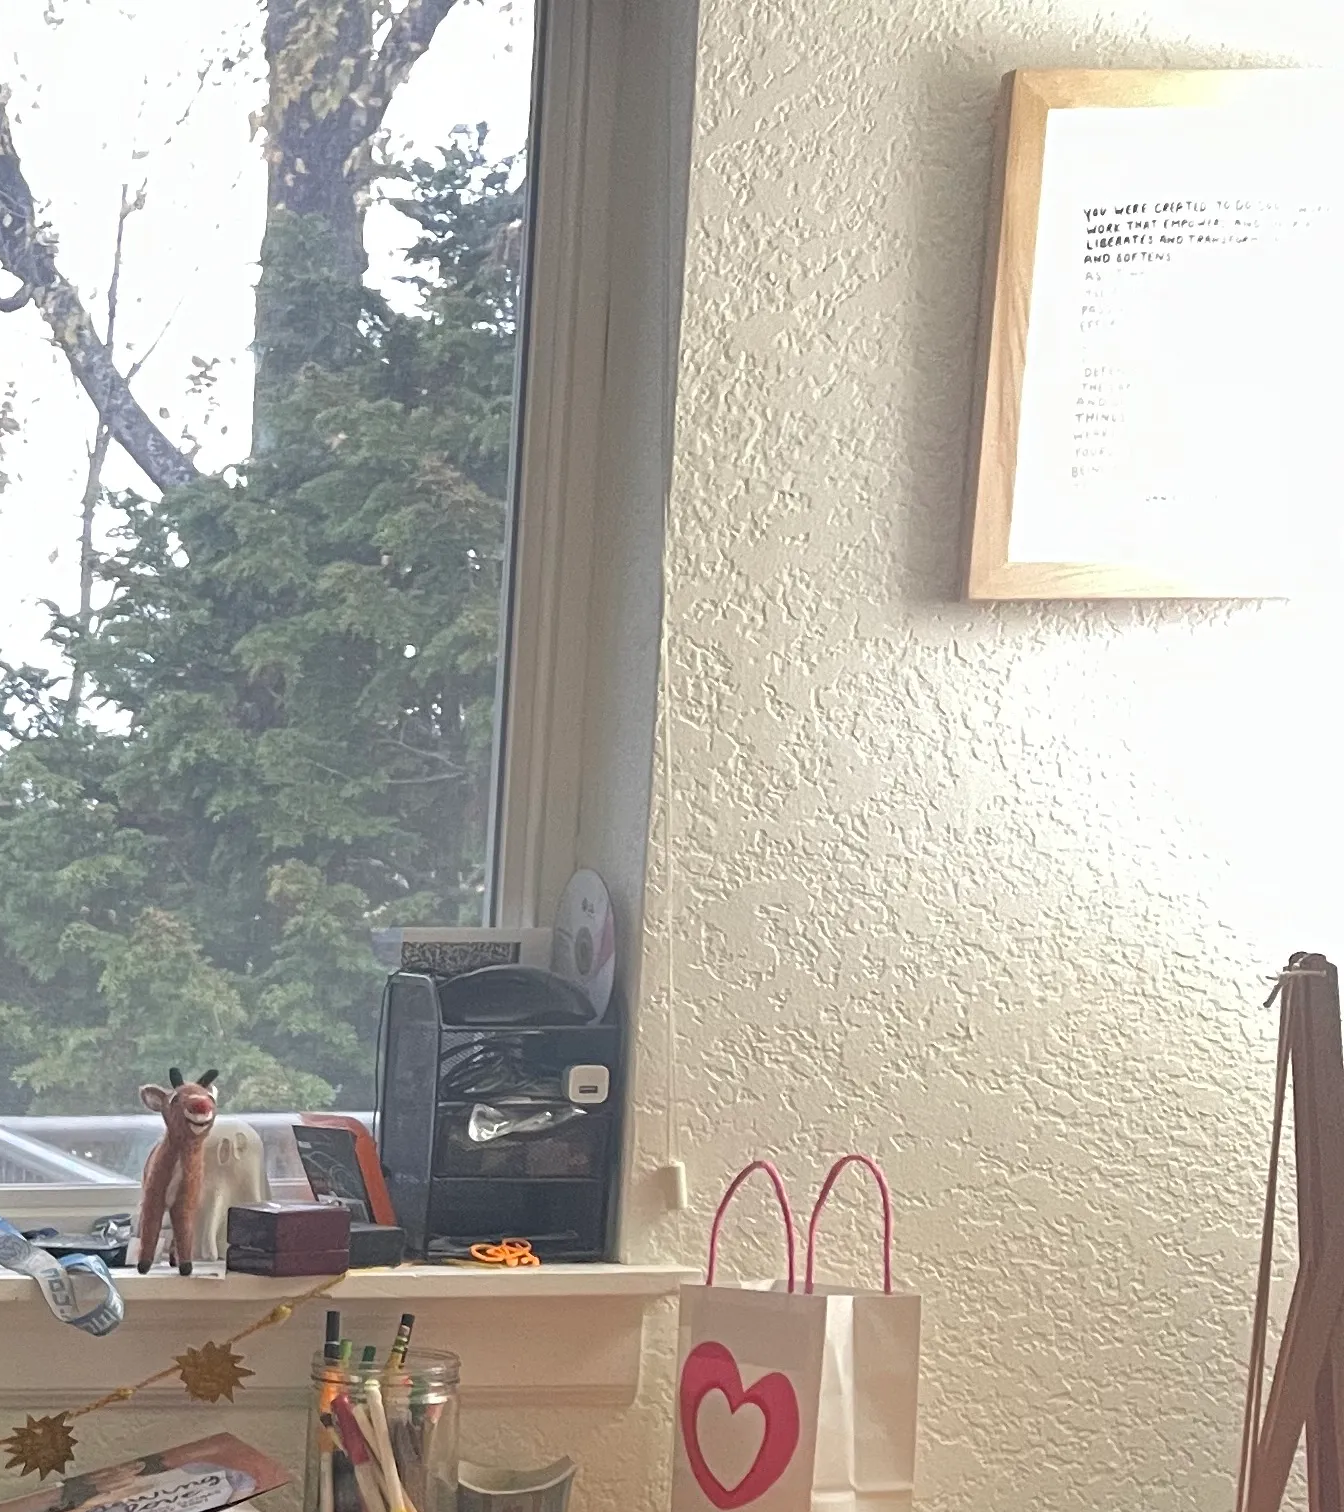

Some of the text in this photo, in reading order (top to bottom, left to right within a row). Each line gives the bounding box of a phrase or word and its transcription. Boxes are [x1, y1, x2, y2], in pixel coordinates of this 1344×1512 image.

[1083, 207, 1107, 222] YOU
[1114, 203, 1147, 214] WERE
[1154, 200, 1207, 213] CREATED
[1086, 223, 1120, 235] WORK
[1127, 219, 1158, 231] THAT
[1163, 218, 1225, 230] EMPOWER
[1086, 234, 1153, 250] LIBERATES
[1159, 235, 1185, 245] AND
[1083, 251, 1171, 264] AND SOFTENS
